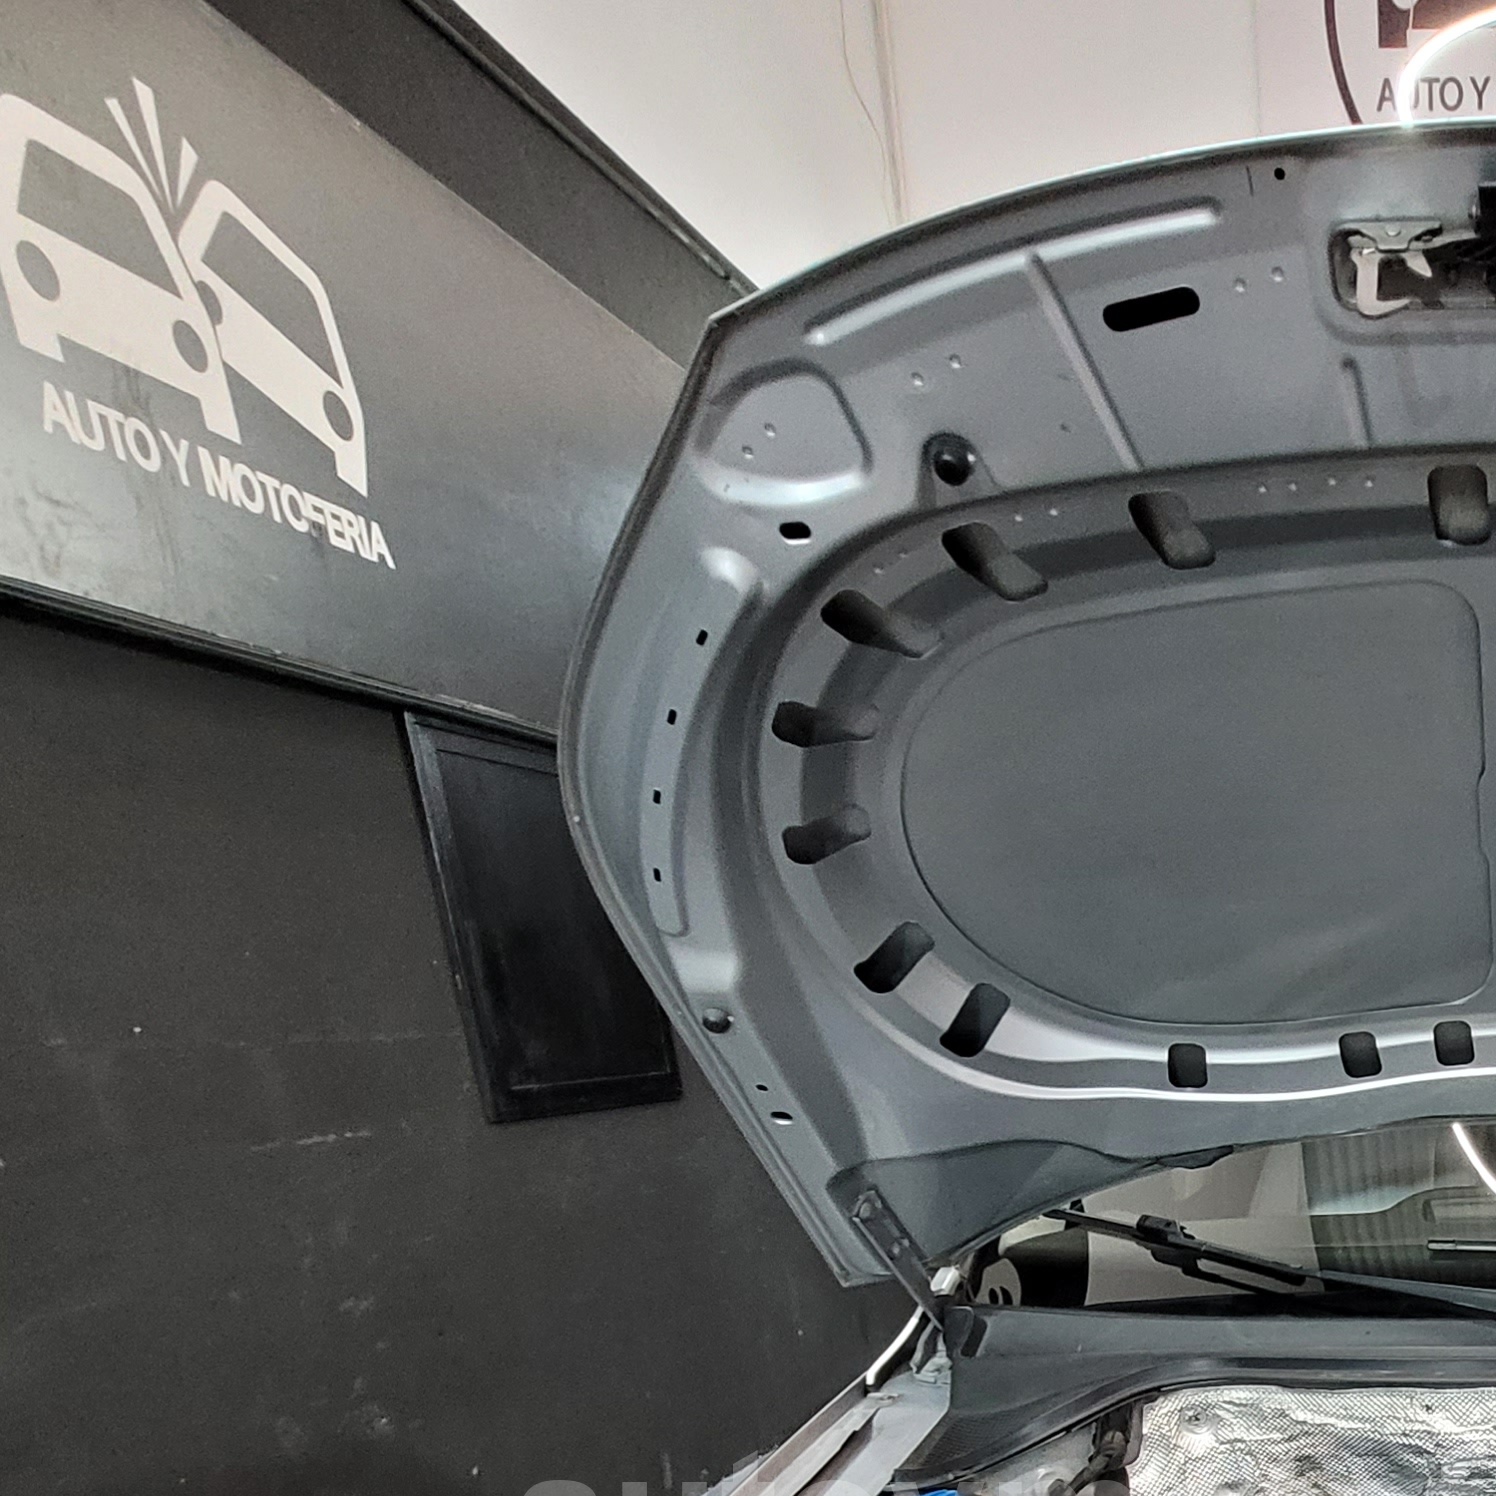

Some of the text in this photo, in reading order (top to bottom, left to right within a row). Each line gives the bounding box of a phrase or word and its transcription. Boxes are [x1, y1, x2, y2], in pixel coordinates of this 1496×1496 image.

[1471, 76, 1491, 111] Y
[43, 380, 396, 570] AUTO Y MOTOFERIA
